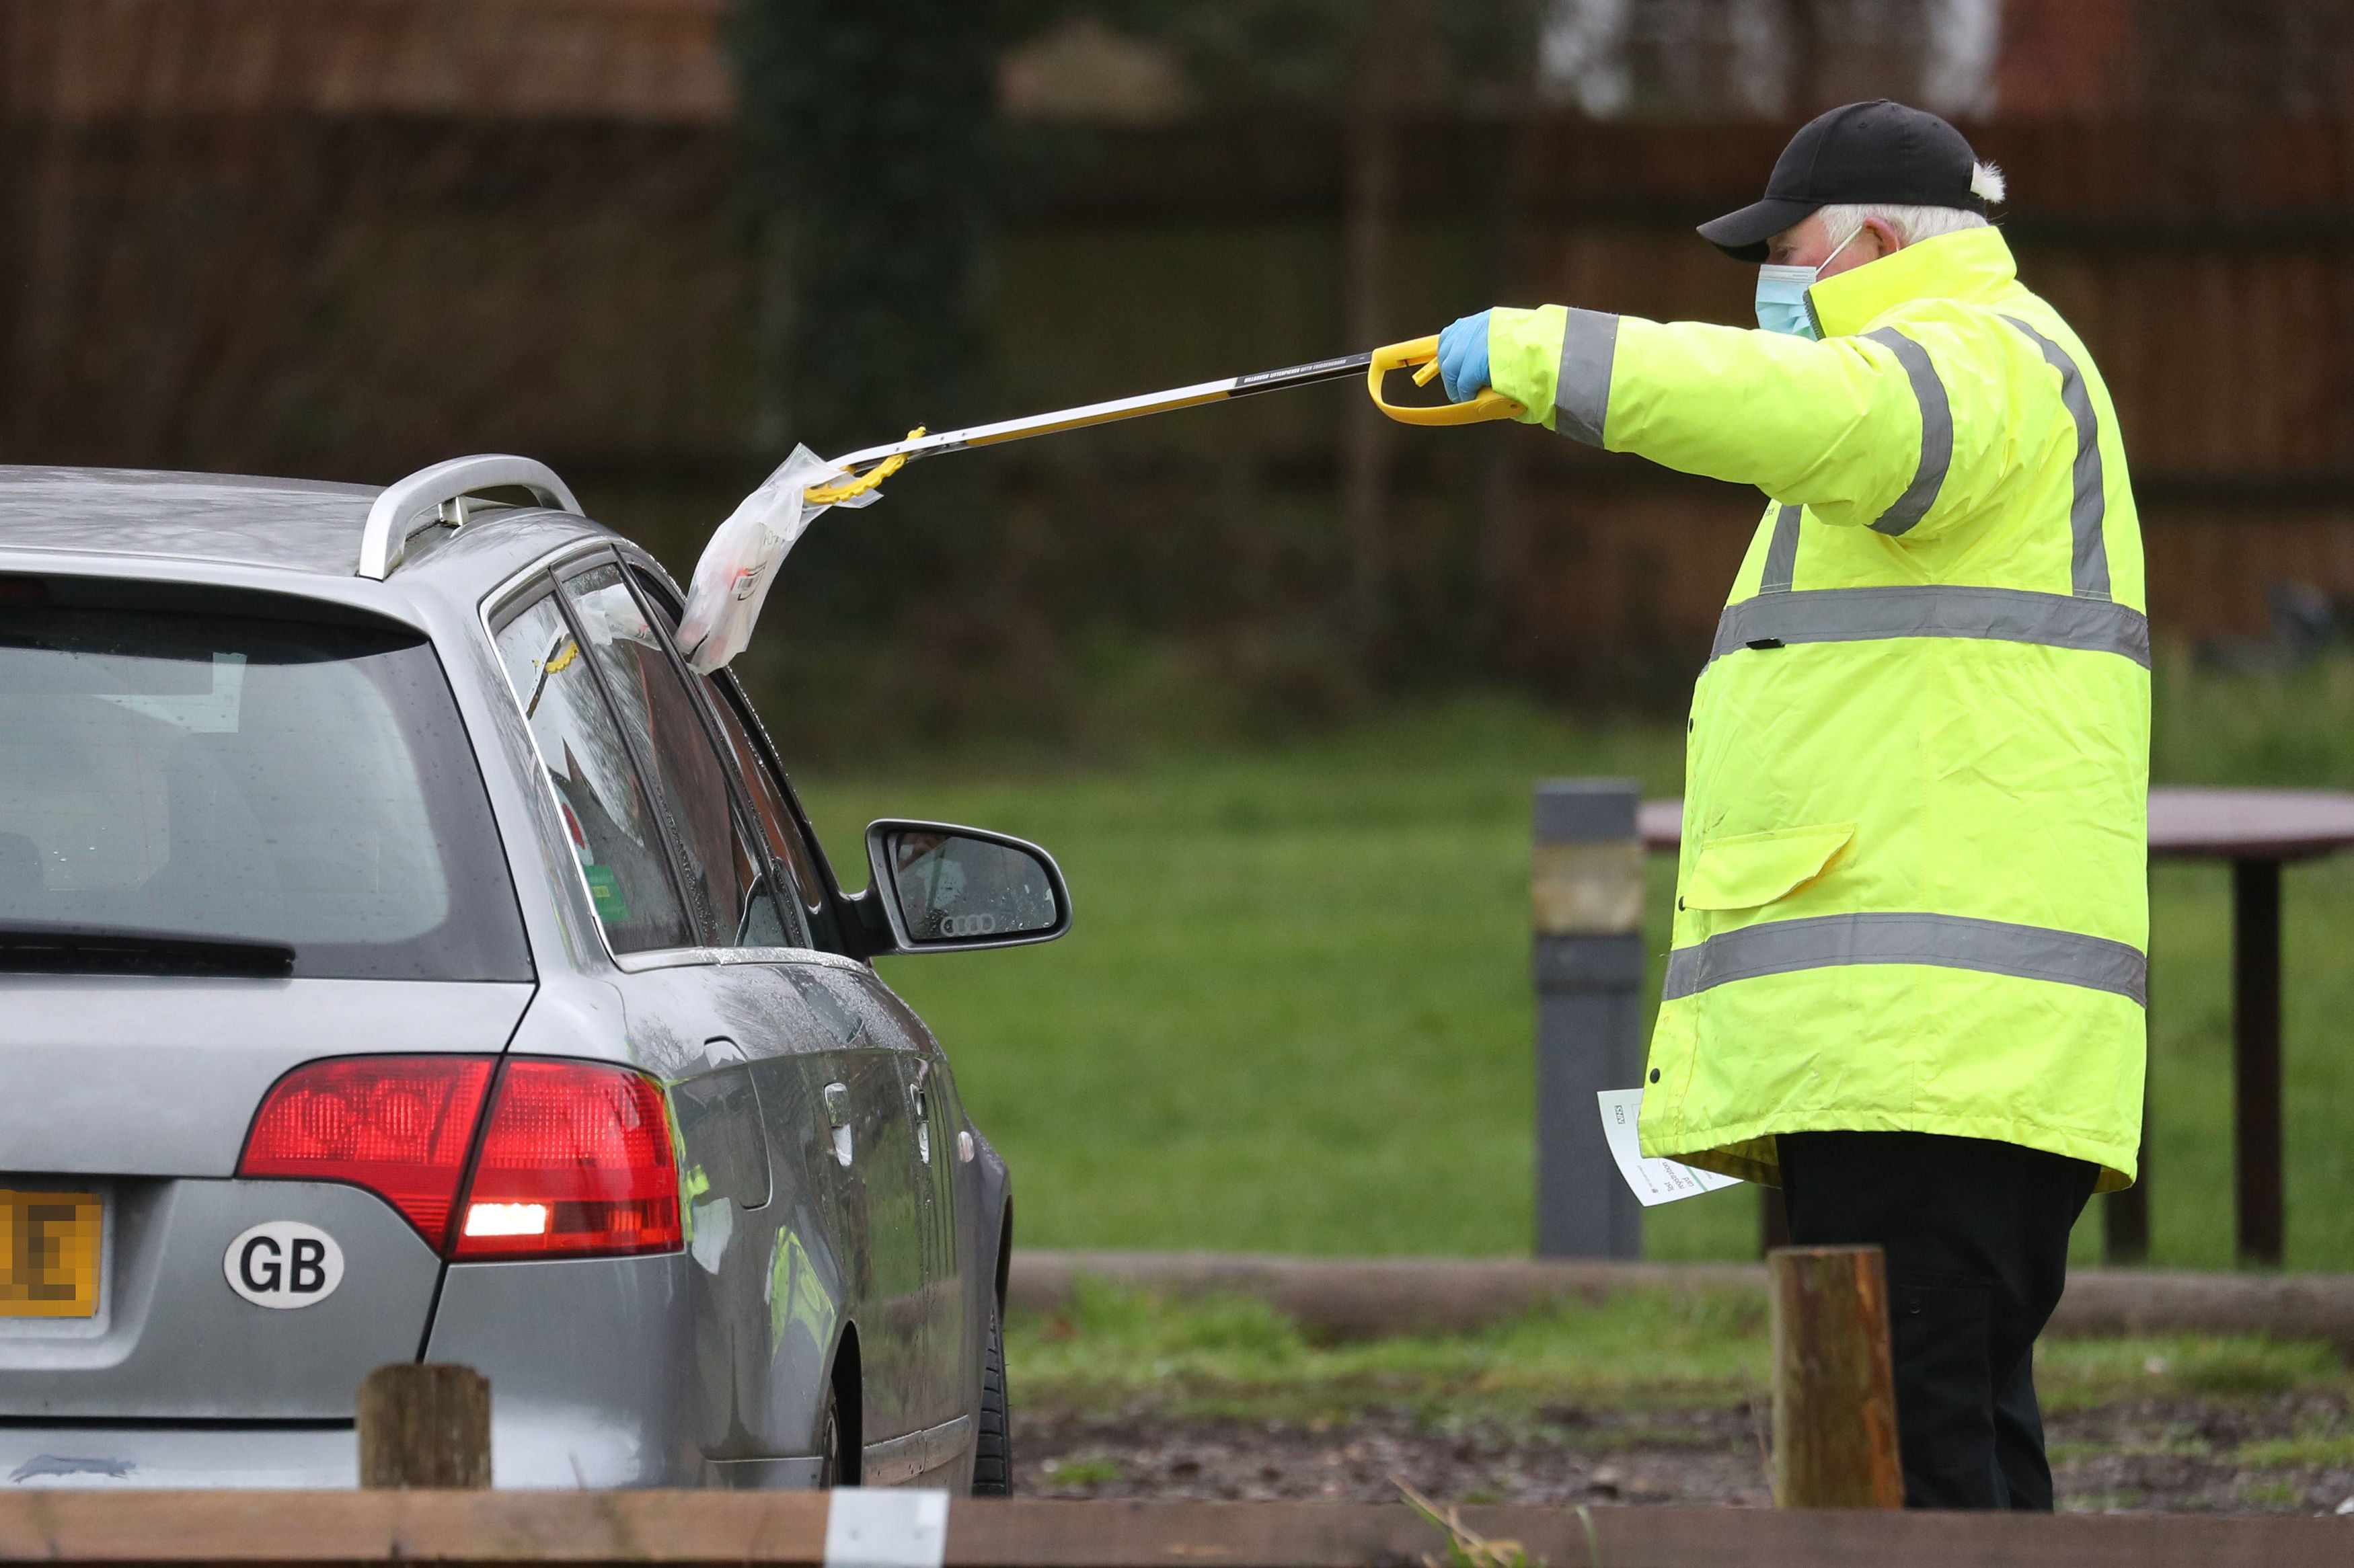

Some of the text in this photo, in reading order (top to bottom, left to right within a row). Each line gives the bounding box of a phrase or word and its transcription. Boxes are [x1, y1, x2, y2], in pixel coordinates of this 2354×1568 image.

[1615, 1105, 1625, 1124] NHS
[1663, 1162, 1684, 1189] registration
[1681, 1177, 1694, 1187] card
[1664, 1181, 1675, 1191] Test
[240, 1236, 326, 1293] GB
